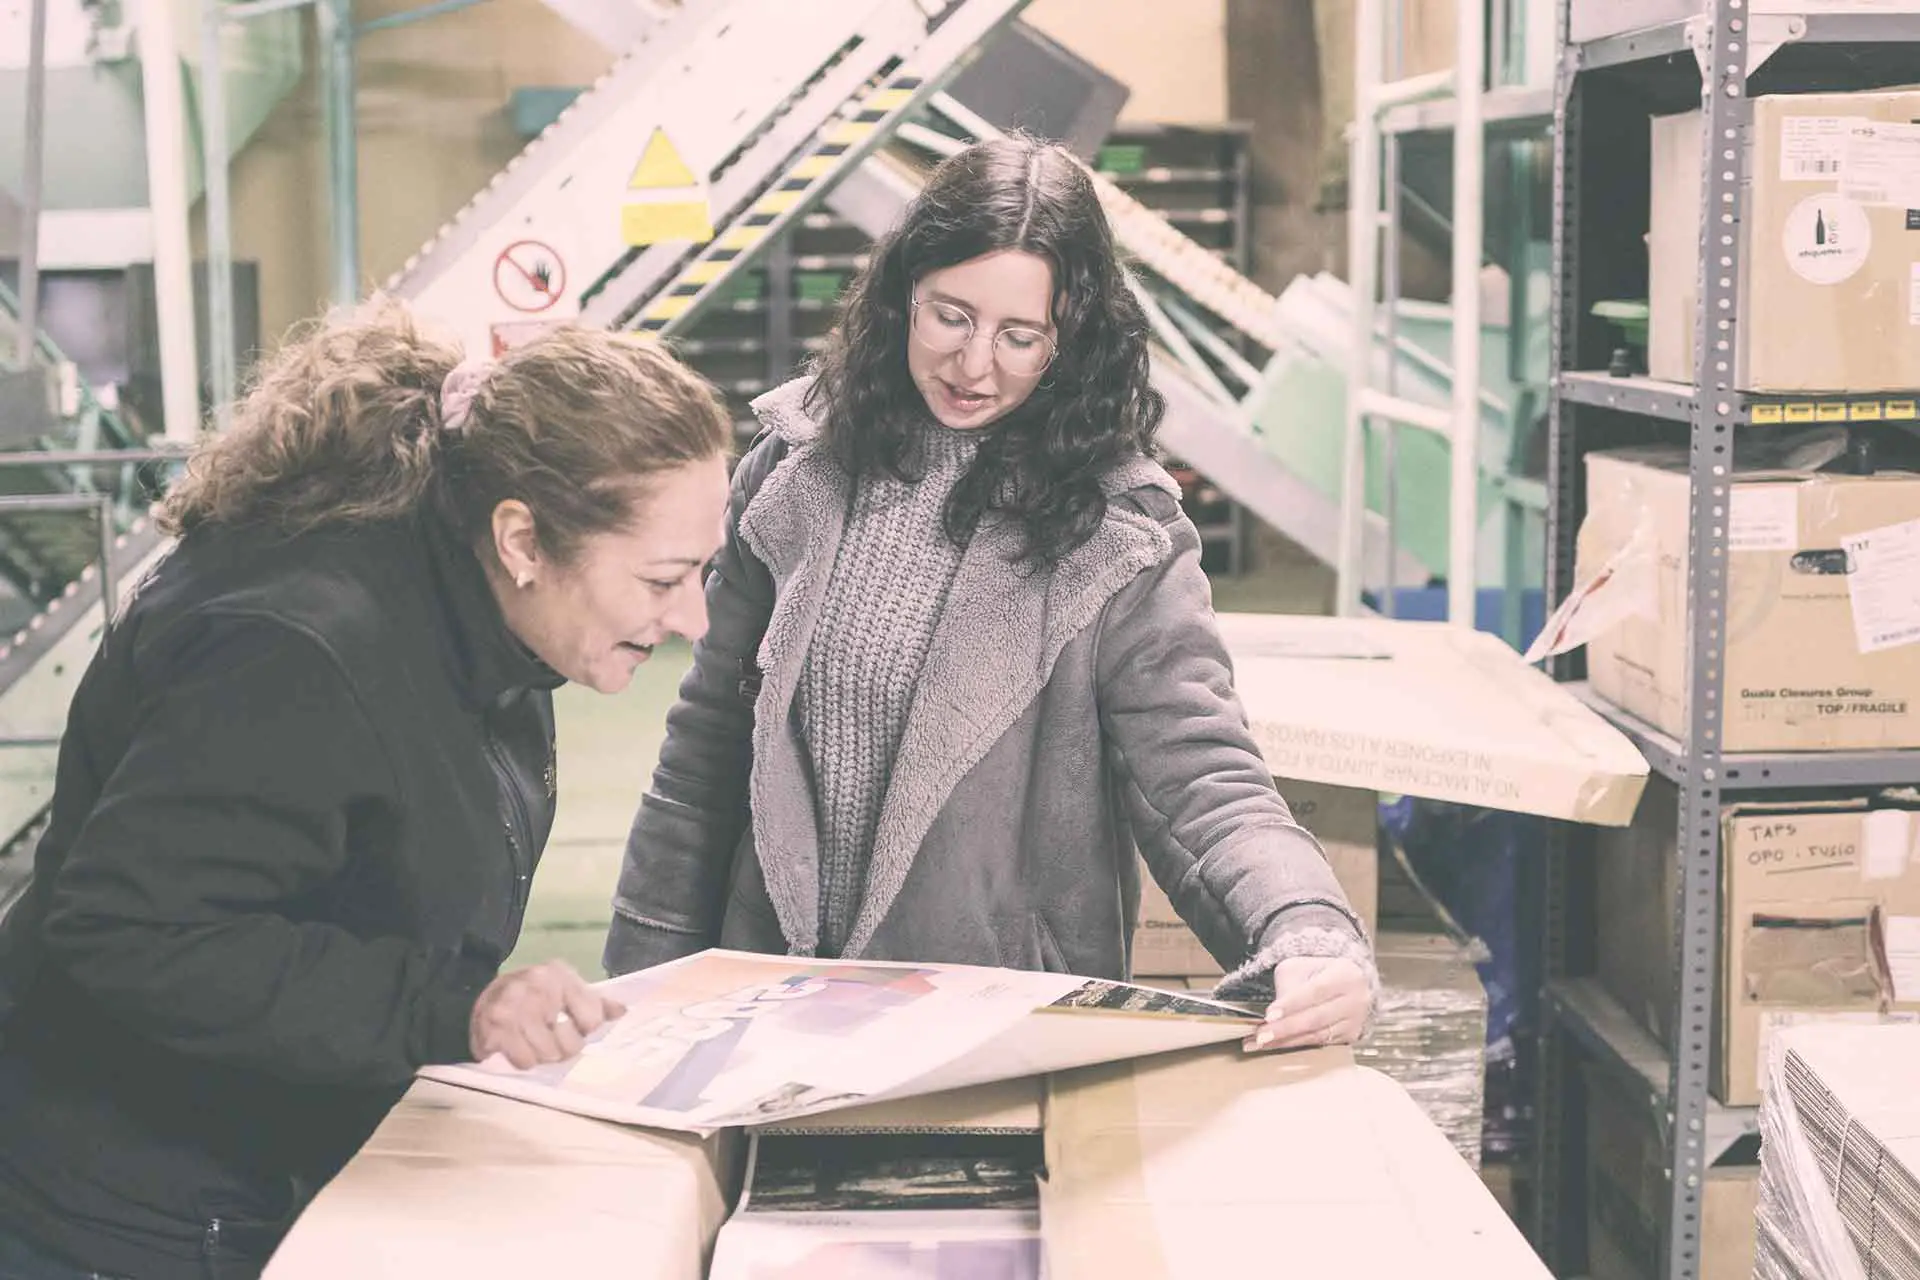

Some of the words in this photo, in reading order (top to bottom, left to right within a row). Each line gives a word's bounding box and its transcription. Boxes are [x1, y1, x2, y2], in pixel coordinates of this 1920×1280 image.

[1779, 687, 1833, 699] Closures
[1836, 686, 1873, 699] Group
[1748, 823, 1797, 842] TAPS
